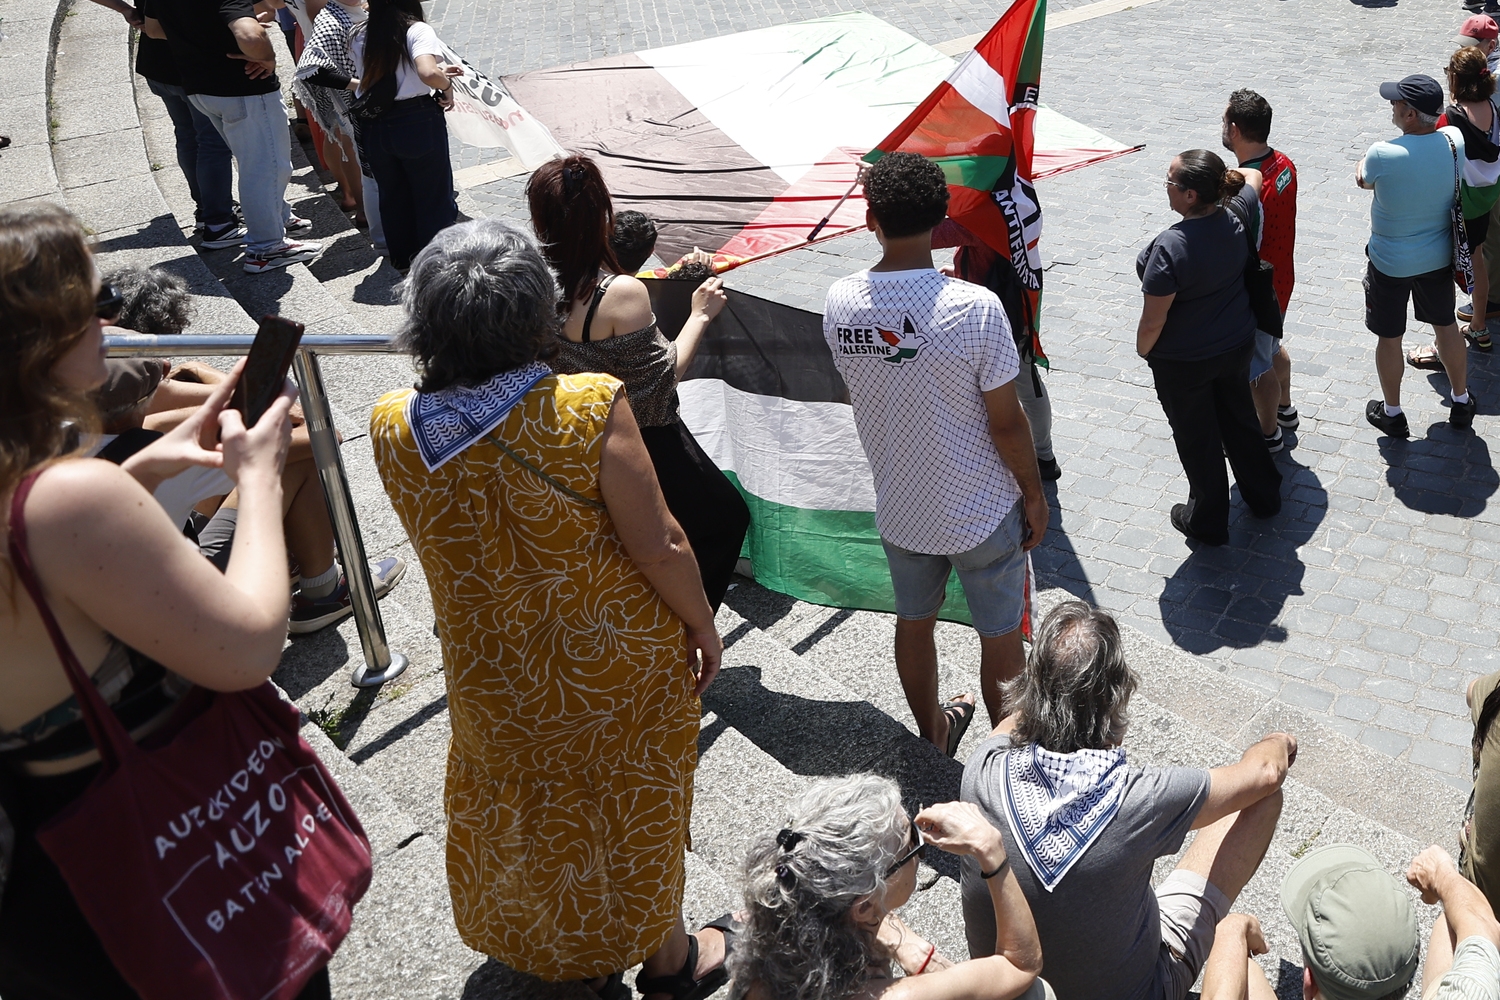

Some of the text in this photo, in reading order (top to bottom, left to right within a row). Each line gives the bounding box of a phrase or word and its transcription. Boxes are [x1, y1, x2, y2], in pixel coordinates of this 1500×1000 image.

[992, 189, 1041, 290] ANTIFAXISTA
[836, 327, 874, 344] FREE
[839, 345, 892, 356] PALESTINE
[214, 782, 286, 870] AUZO
[284, 802, 333, 864] ALDE
